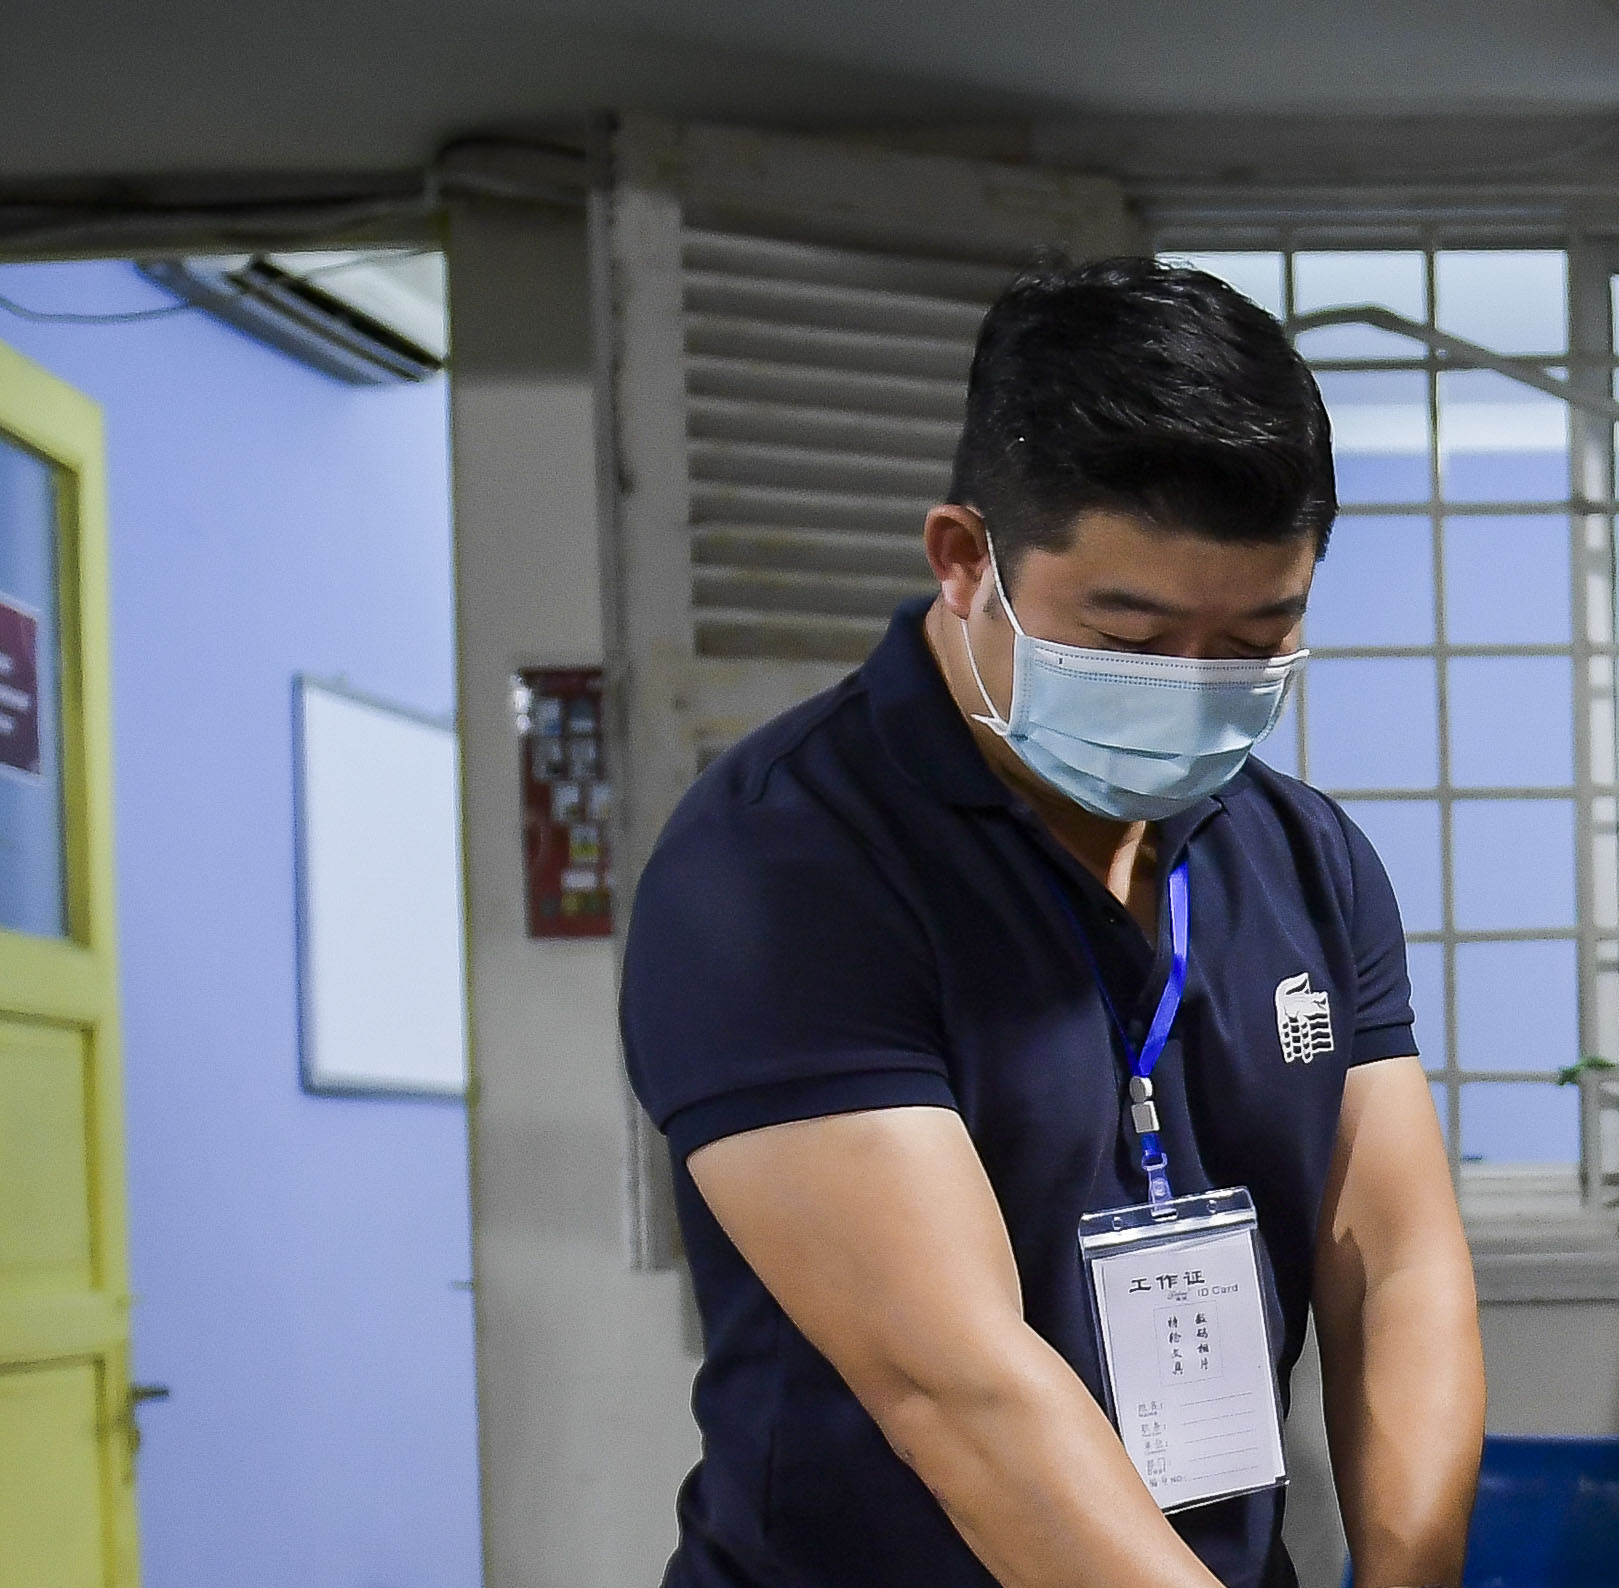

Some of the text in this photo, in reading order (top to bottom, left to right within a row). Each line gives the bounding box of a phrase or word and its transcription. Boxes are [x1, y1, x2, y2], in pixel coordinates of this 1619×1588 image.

[1129, 1270, 1206, 1293] 工作证
[1197, 1288, 1209, 1297] ID
[1212, 1284, 1239, 1295] Card
